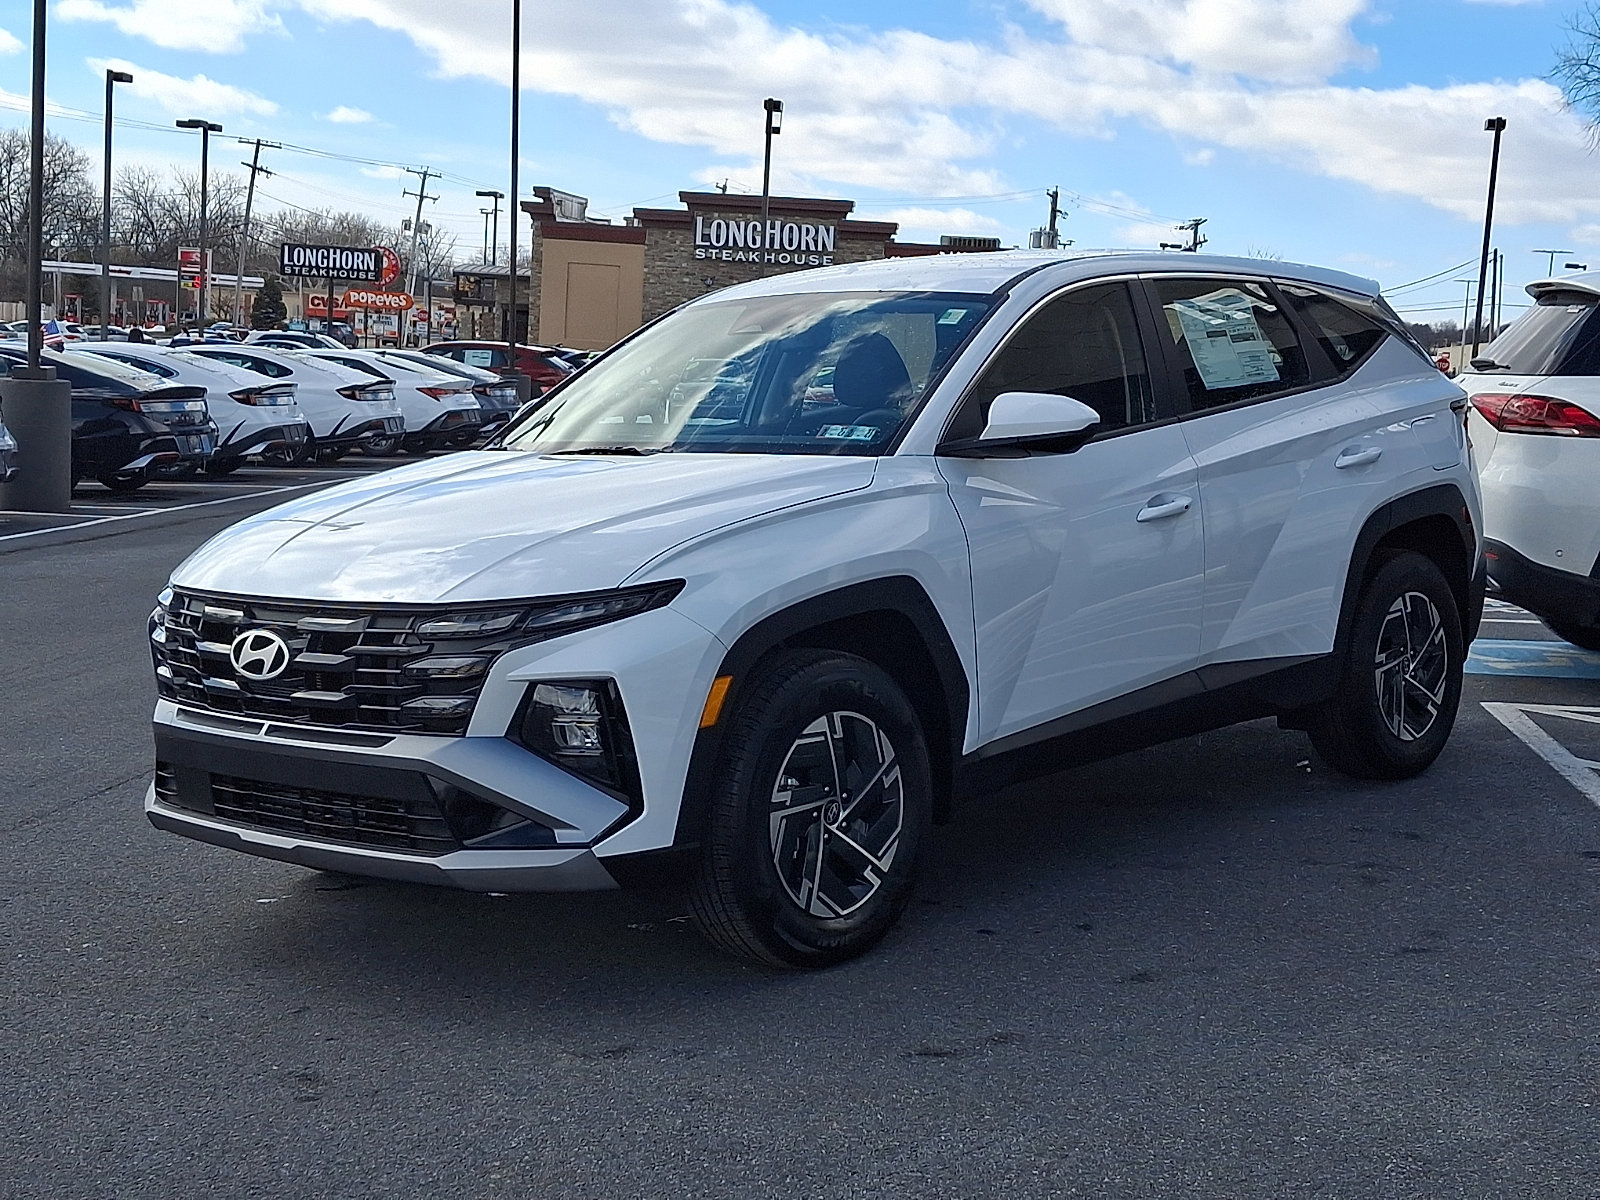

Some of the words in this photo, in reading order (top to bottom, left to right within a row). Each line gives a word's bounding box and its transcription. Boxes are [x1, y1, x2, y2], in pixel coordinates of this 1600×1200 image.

[695, 216, 835, 252] LONGHORN
[284, 245, 376, 271] LONGHORN
[695, 248, 834, 266] STEAKHOUSE
[284, 266, 376, 280] STEAKHOUSE
